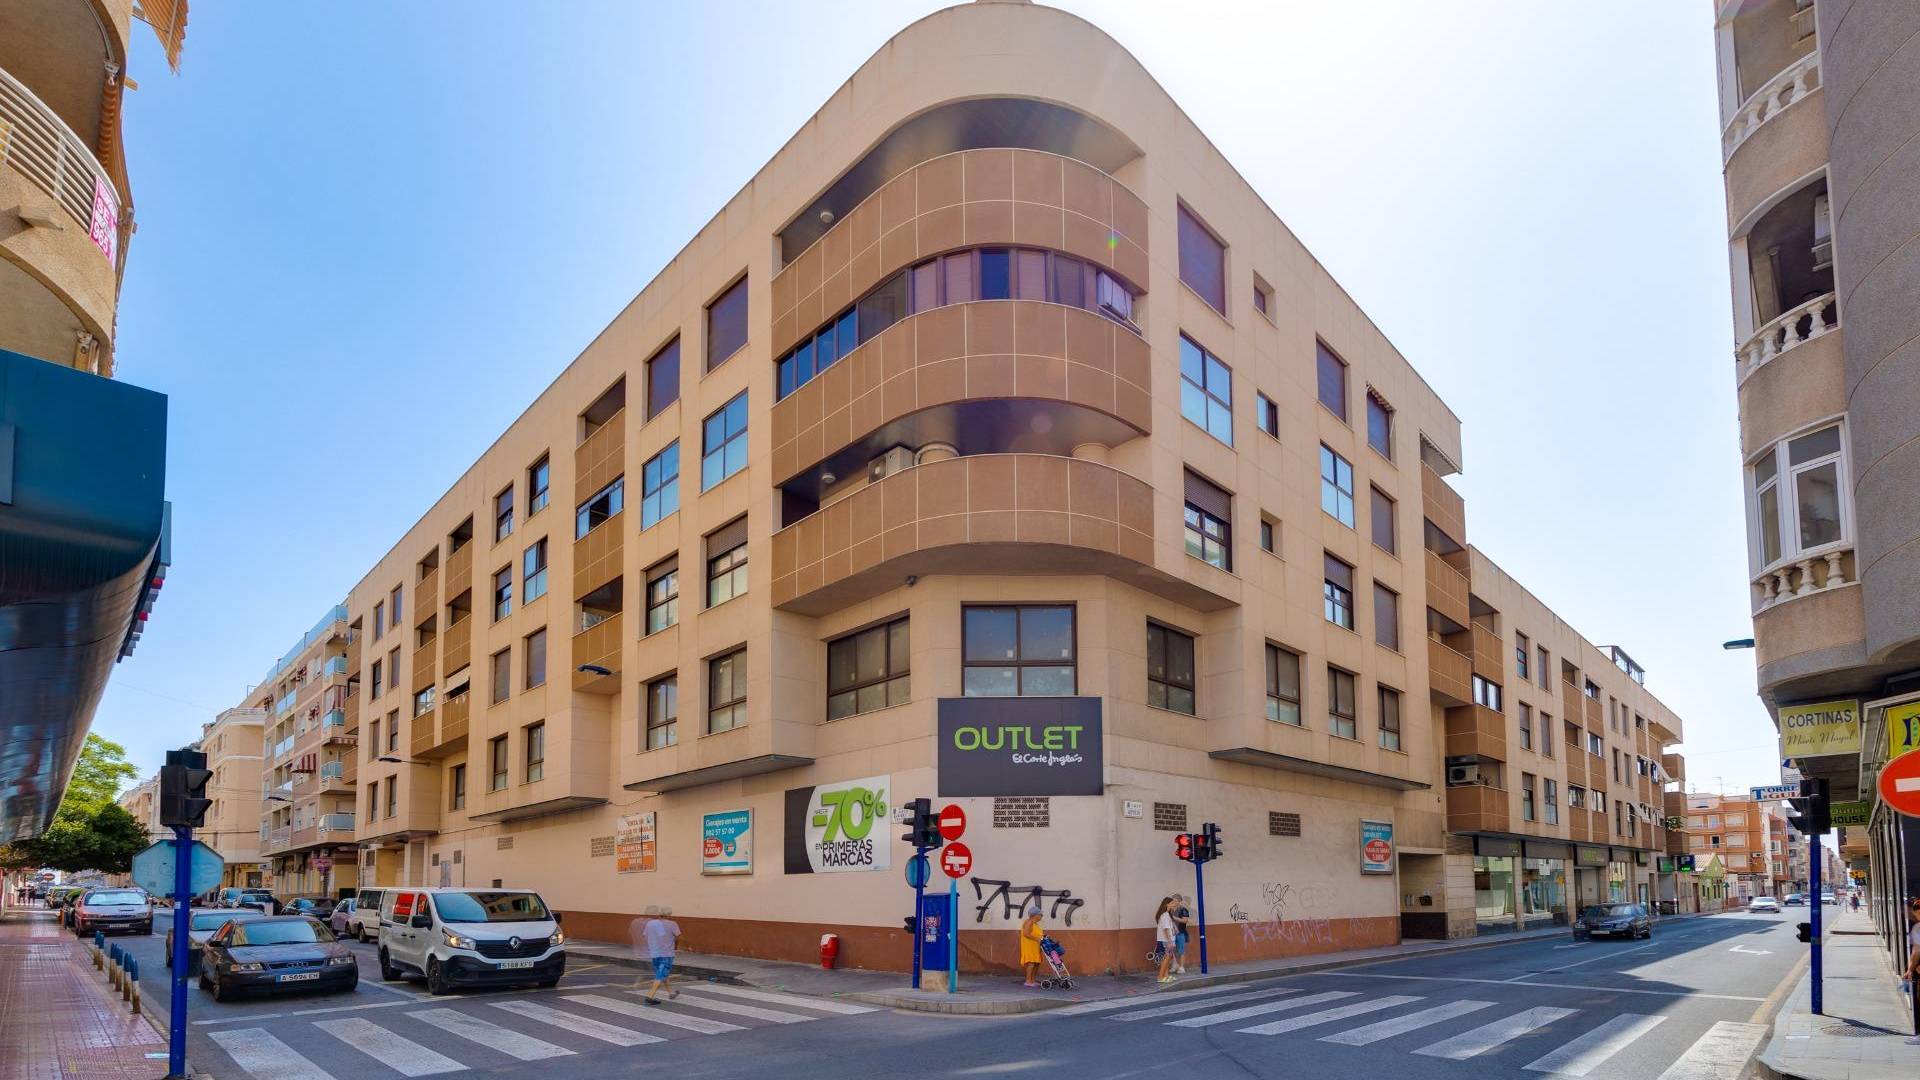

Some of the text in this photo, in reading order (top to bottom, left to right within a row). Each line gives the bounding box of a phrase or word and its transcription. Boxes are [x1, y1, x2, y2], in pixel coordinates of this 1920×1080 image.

[1787, 709, 1852, 728] CORTINAS
[954, 726, 1084, 751] OUTLET
[1012, 753, 1023, 763] El
[1024, 753, 1047, 763] Corte
[822, 839, 873, 853] PRIMERAS
[822, 850, 873, 866] MARCAS
